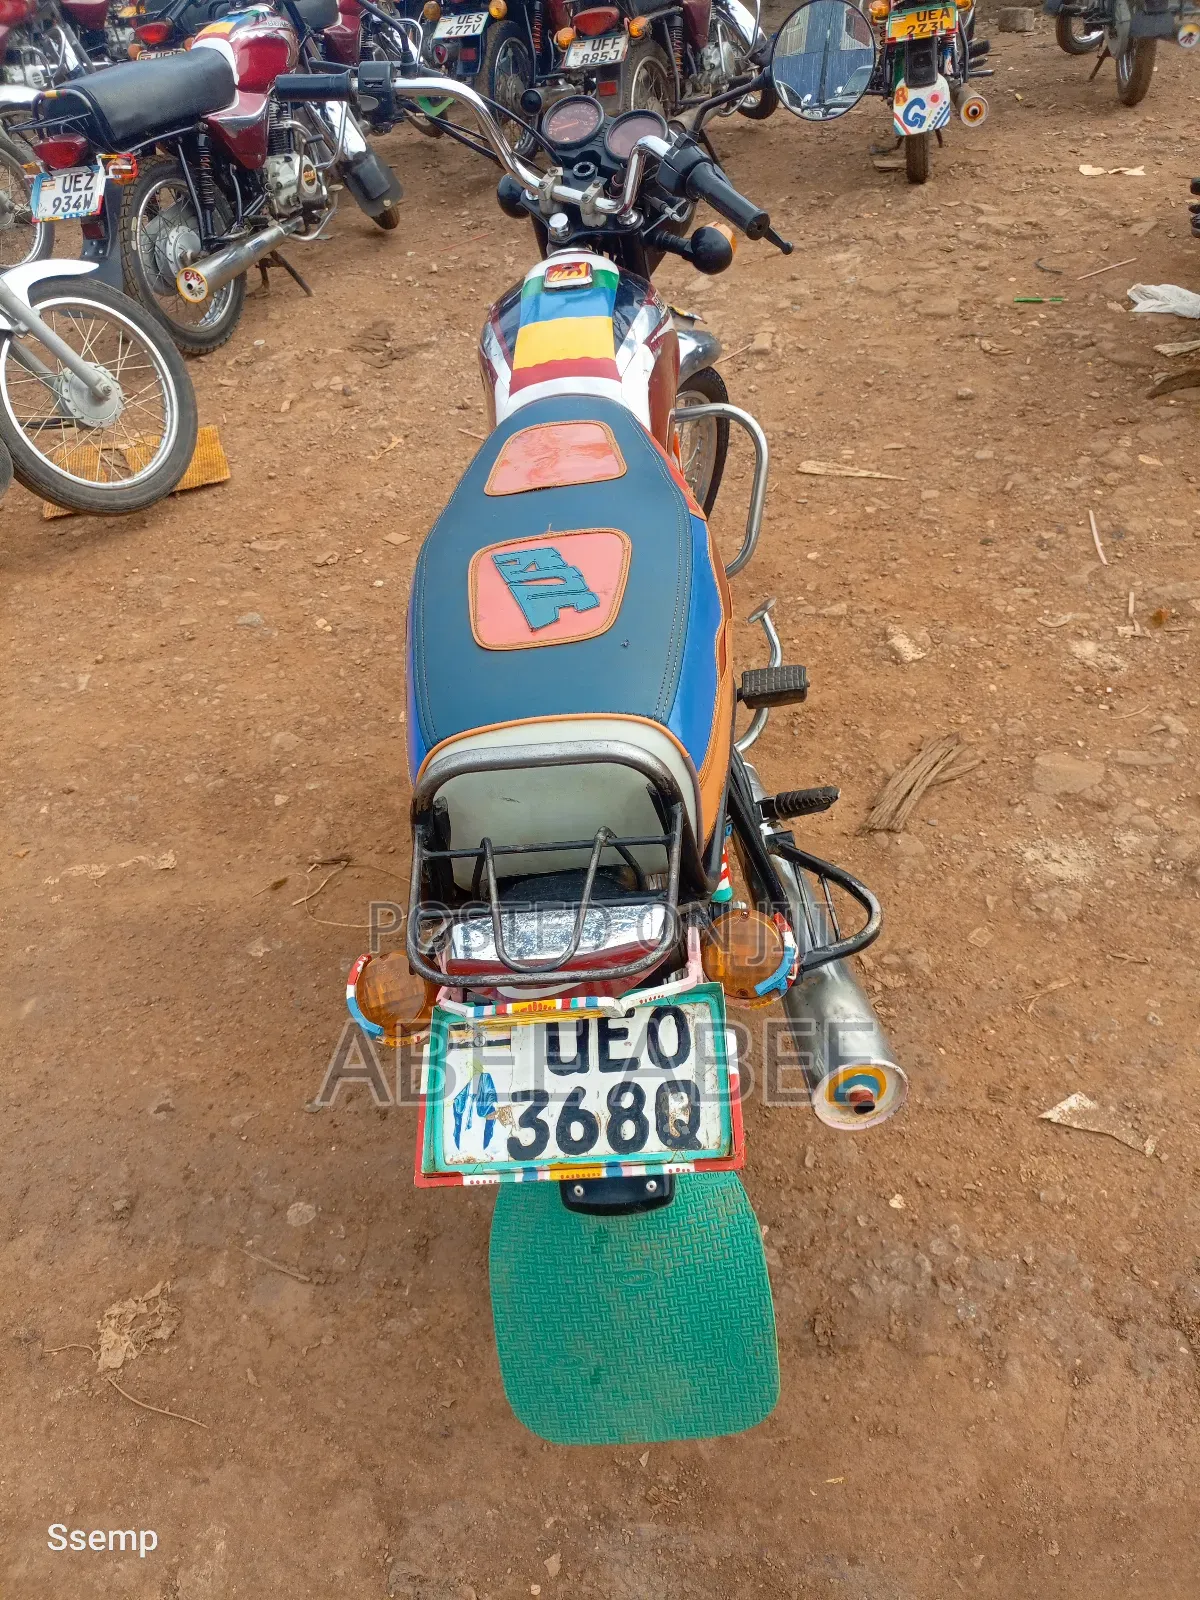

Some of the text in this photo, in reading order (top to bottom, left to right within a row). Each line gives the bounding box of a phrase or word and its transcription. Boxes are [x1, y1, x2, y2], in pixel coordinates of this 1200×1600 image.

[457, 13, 484, 25] UES
[916, 7, 950, 22] UEA
[446, 24, 480, 36] 477V
[592, 37, 621, 51] UFF
[581, 50, 619, 63] 885J
[62, 173, 95, 193] UEZ
[52, 192, 93, 214] 934W
[506, 1080, 702, 1162] 368Q
